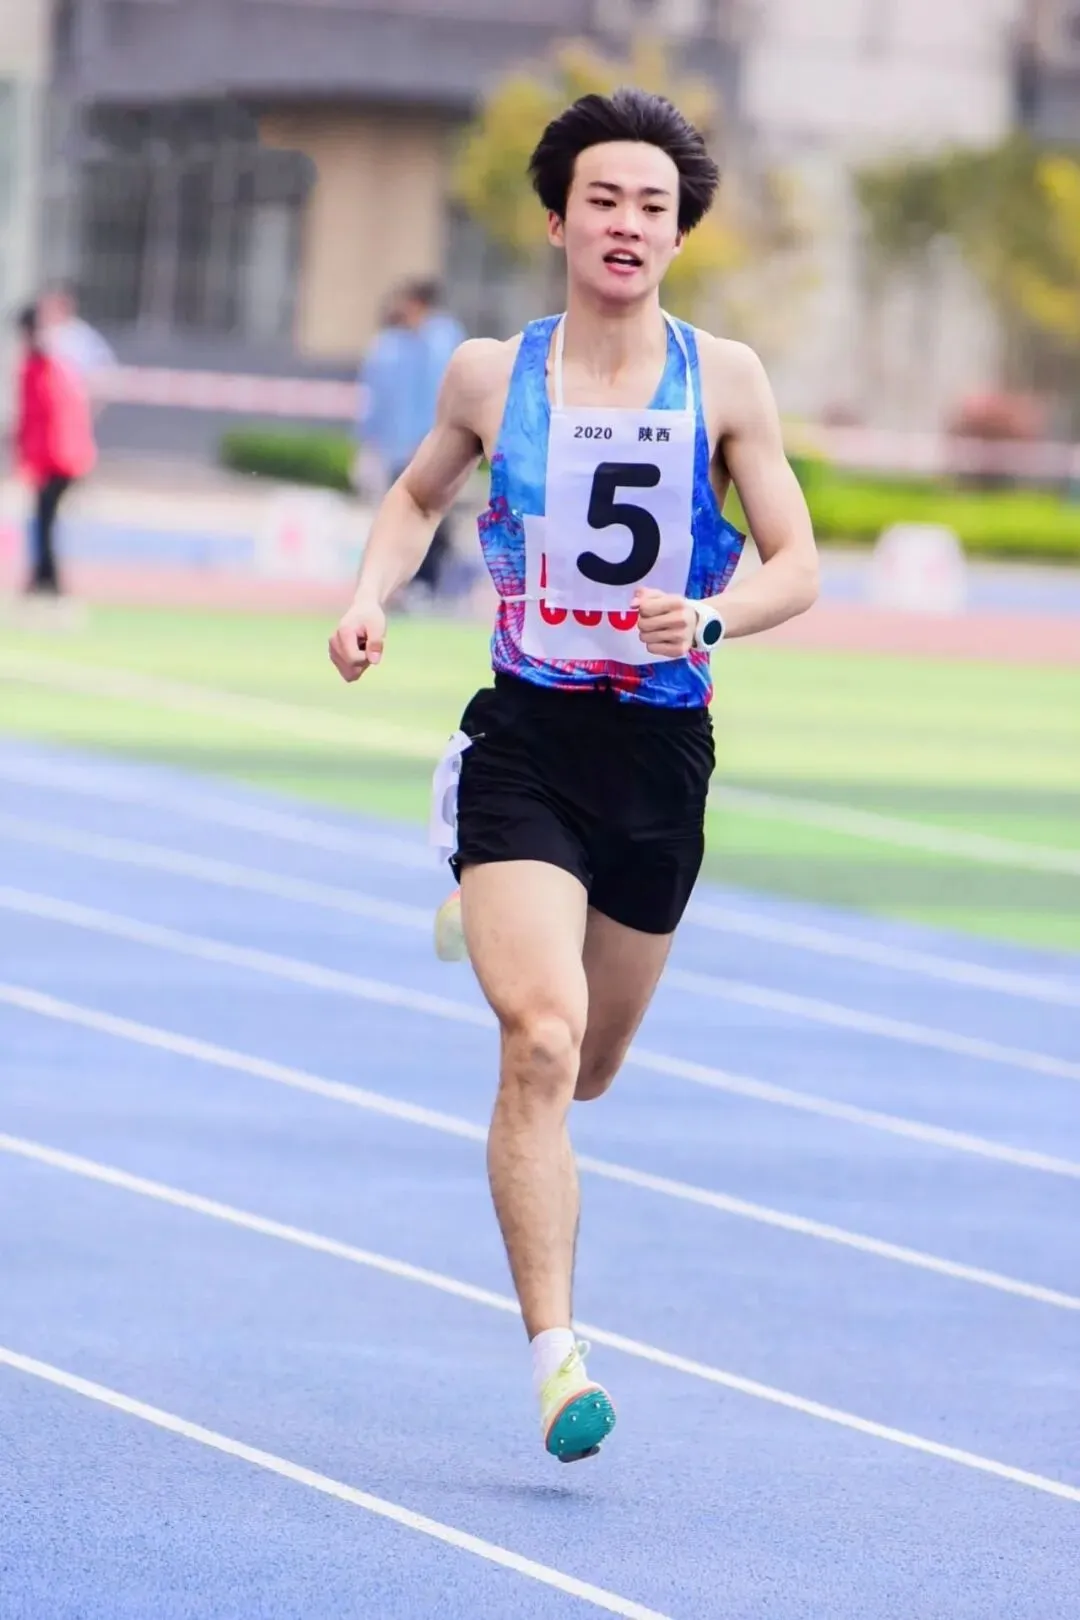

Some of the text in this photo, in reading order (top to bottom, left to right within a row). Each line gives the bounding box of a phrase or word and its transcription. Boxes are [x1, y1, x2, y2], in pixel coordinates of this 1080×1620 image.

[574, 426, 671, 442] 2020 陕西
[577, 462, 661, 585] 5
